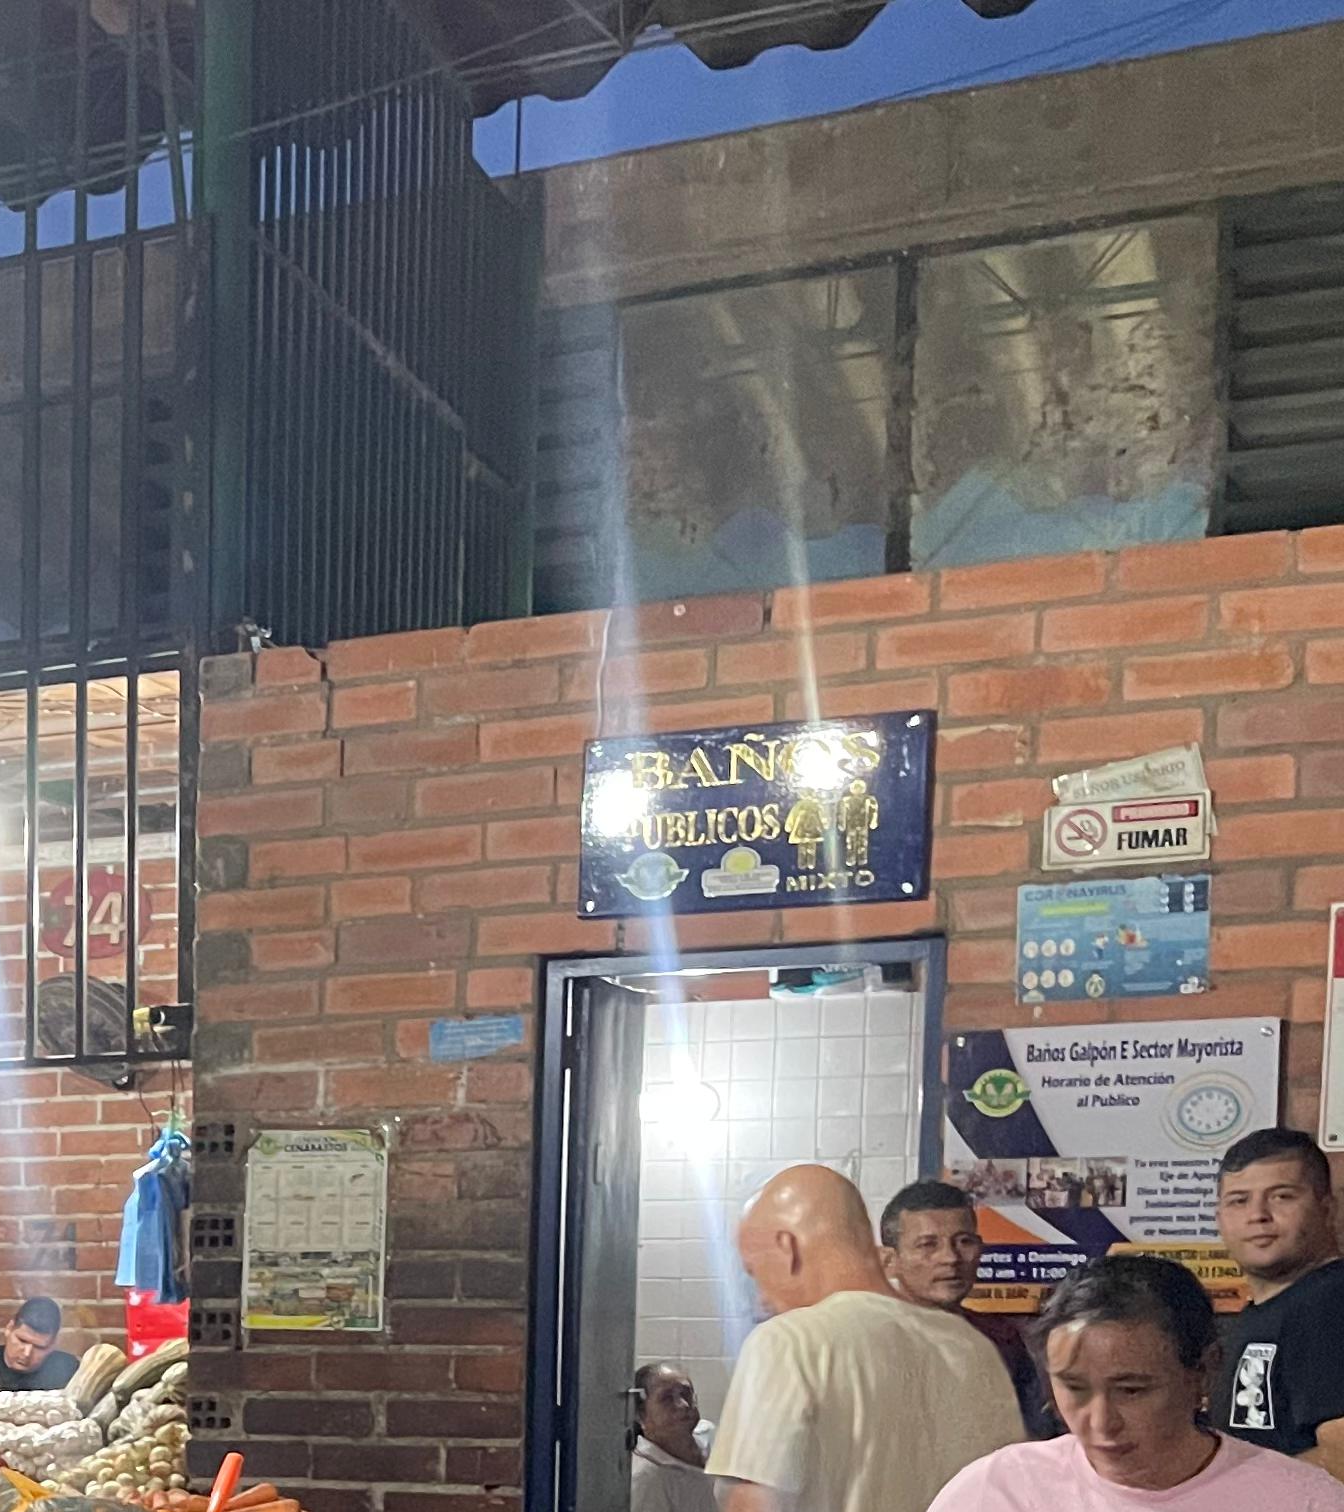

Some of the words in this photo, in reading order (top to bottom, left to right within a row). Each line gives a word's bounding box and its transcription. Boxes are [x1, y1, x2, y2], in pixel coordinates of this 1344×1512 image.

[1116, 827, 1188, 851] FUMAR
[785, 869, 875, 892] MIXTO
[1026, 1043, 1065, 1064] Baños
[1069, 1041, 1117, 1067] Galpón
[1120, 1042, 1129, 1060] E
[1132, 1040, 1172, 1059] Sector
[1176, 1038, 1244, 1064] Mayorista
[1041, 1074, 1091, 1088] Horario
[1095, 1073, 1110, 1087] de
[1113, 1072, 1175, 1086] Atención
[1077, 1095, 1089, 1107] al
[979, 1252, 1012, 1263] artes
